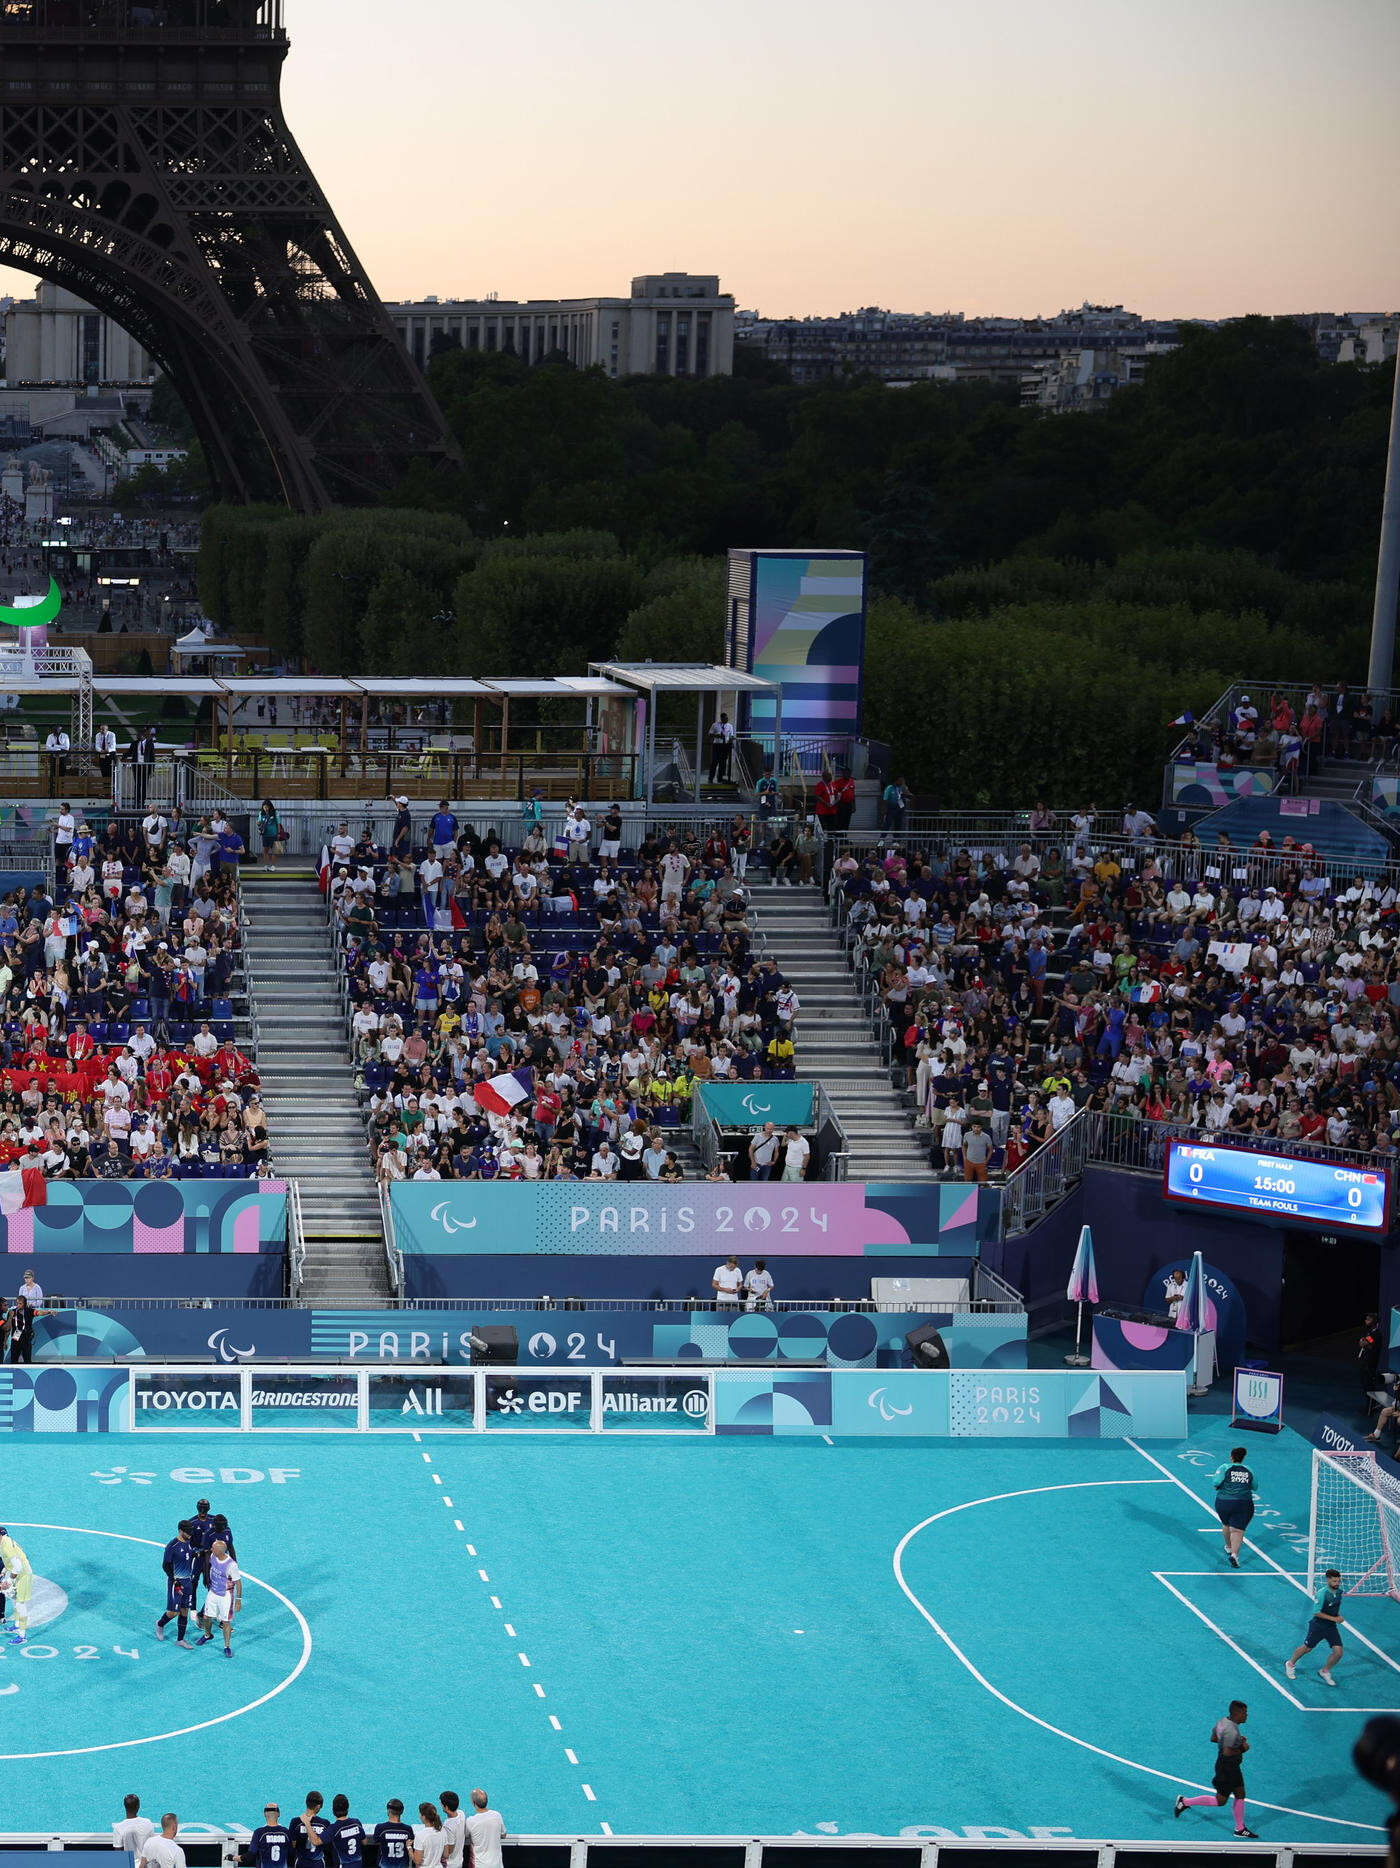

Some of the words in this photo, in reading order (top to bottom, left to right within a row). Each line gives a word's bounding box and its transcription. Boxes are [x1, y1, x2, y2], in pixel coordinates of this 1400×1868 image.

[1189, 1163, 1203, 1183] 0
[1334, 1170, 1362, 1184] CHN
[1254, 1175, 1296, 1195] 15:00
[1248, 1197, 1272, 1208] TEAM
[1272, 1201, 1299, 1211] FOULS
[1347, 1188, 1362, 1207] 0
[714, 1206, 828, 1233] 2024
[528, 1332, 615, 1359] 024
[137, 1391, 238, 1410] TOYOTA
[603, 1392, 678, 1412] Allianz
[976, 1406, 1041, 1424] 2024
[1321, 1425, 1356, 1452] TOYOTA
[270, 1845, 281, 1862] 6
[347, 1838, 357, 1855] 3
[387, 1842, 405, 1858] 13
